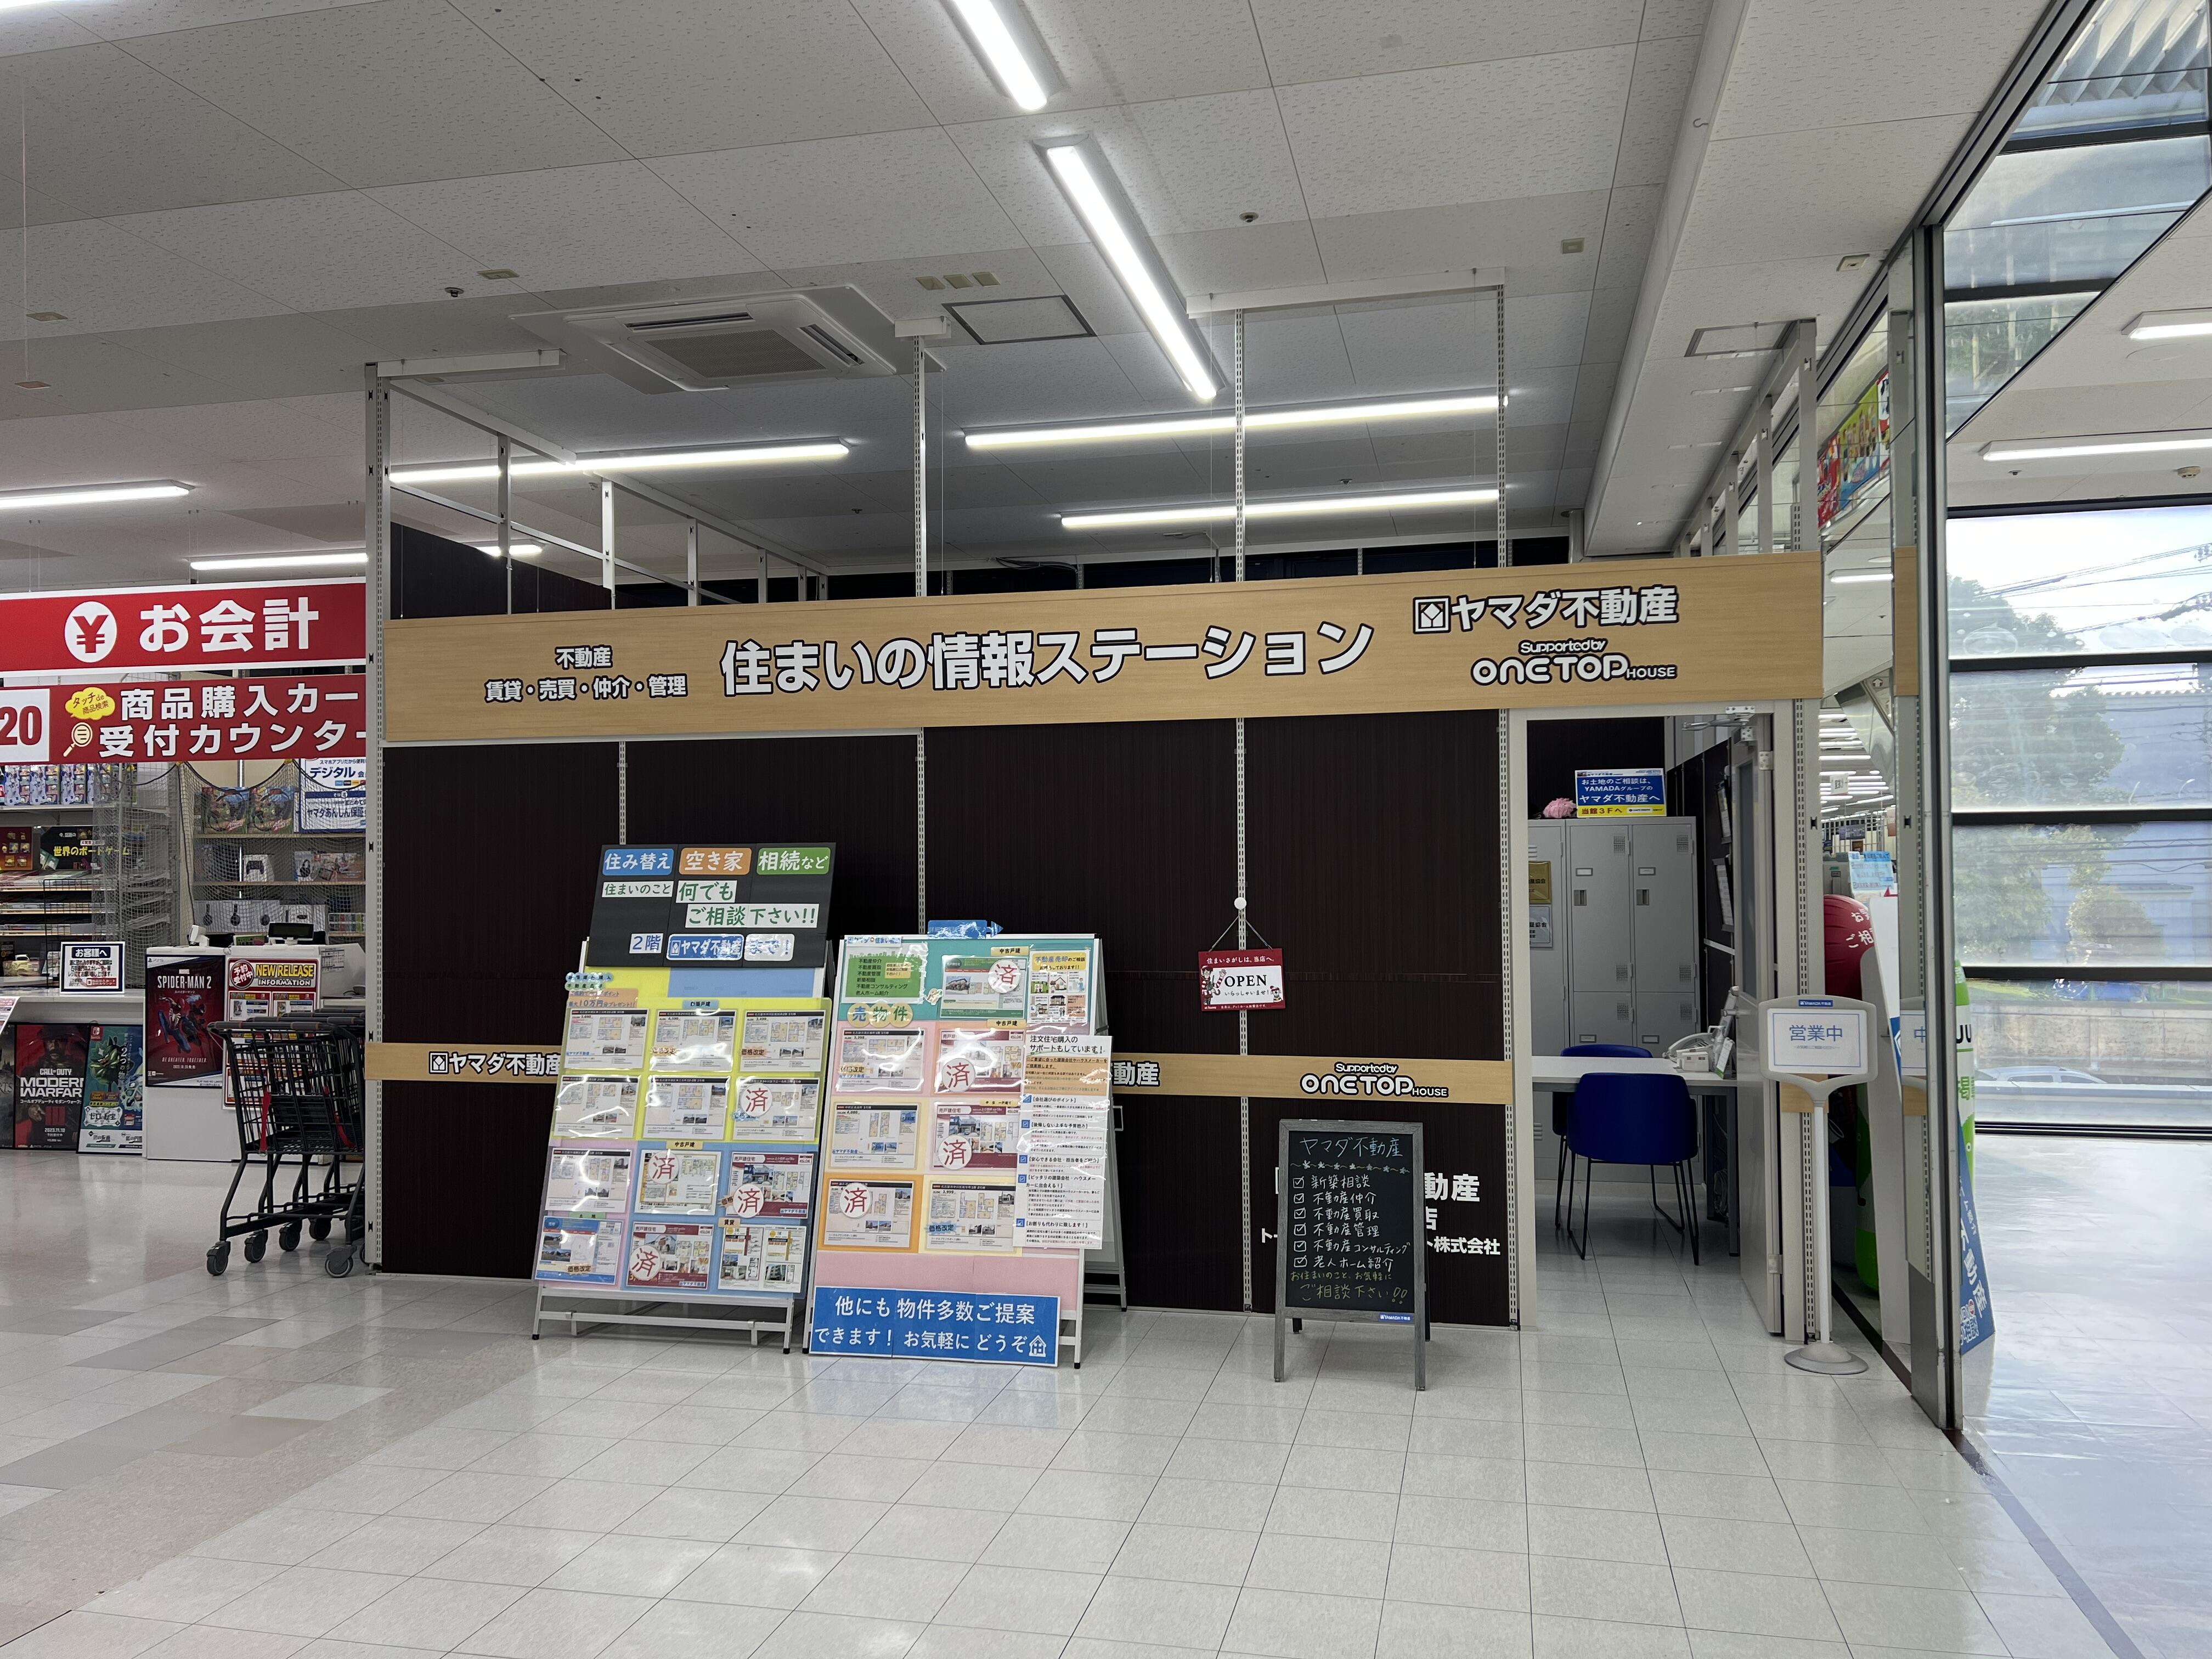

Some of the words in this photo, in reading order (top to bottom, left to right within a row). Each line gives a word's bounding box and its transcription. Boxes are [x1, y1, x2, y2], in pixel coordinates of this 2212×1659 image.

[1452, 585, 1679, 632] ヤマダ不動産
[139, 596, 319, 652] お会計
[556, 646, 613, 669] 不動産
[721, 622, 1374, 696] 住まいの情報ステーション
[1626, 666, 1676, 679] HOUSE
[484, 674, 688, 703] 賃貸・売買・仲介・管理
[82, 701, 109, 715] 商品検索
[120, 684, 359, 721] 商品購入カー
[0, 707, 42, 745] 20
[99, 720, 366, 758] 受付カウンタ
[1579, 794, 1661, 803] ヤマダ不動産へ
[605, 851, 671, 871] 住み替え
[686, 851, 744, 871] 空き家
[759, 851, 828, 871] 相続など
[605, 883, 671, 895] 住まいのこと
[679, 882, 733, 901] 何でも
[633, 935, 662, 951] 2階
[1846, 928, 1874, 948] ご相
[75, 949, 107, 957] お客様へ
[1207, 956, 1274, 964] 住まいさがしは、当店へ。
[233, 971, 253, 985] 受付中
[234, 964, 248, 975] 予約
[256, 964, 276, 977] NEW
[277, 964, 314, 978] RELEASE
[157, 976, 204, 989] SPIDER-MAN
[207, 976, 211, 989] 2
[1224, 975, 1267, 987] OPEN
[853, 1006, 907, 1022] 売物件
[1789, 1025, 1843, 1042] 営業中
[449, 1053, 560, 1075] ヤマダ不動産
[1111, 1061, 1159, 1085] 動産
[947, 1062, 969, 1088] 済
[746, 1088, 768, 1112] 済
[1412, 1087, 1447, 1097] HOUSE
[943, 1139, 966, 1165] 済
[1300, 1137, 1403, 1158] ヤマダ不動産
[652, 1155, 675, 1179] 済
[1311, 1175, 1372, 1189] 新築相談
[738, 1188, 760, 1213] 済
[844, 1187, 867, 1213] 済
[1313, 1191, 1376, 1205] 不動産仲介
[1313, 1207, 1380, 1221] 不動産買取
[1262, 1228, 1278, 1243] ト
[1313, 1223, 1380, 1238] 不動産管理
[1313, 1238, 1411, 1255] 不動産コンサルティング
[632, 1248, 658, 1277] 済
[1313, 1256, 1393, 1272] 老人ホーム紹介
